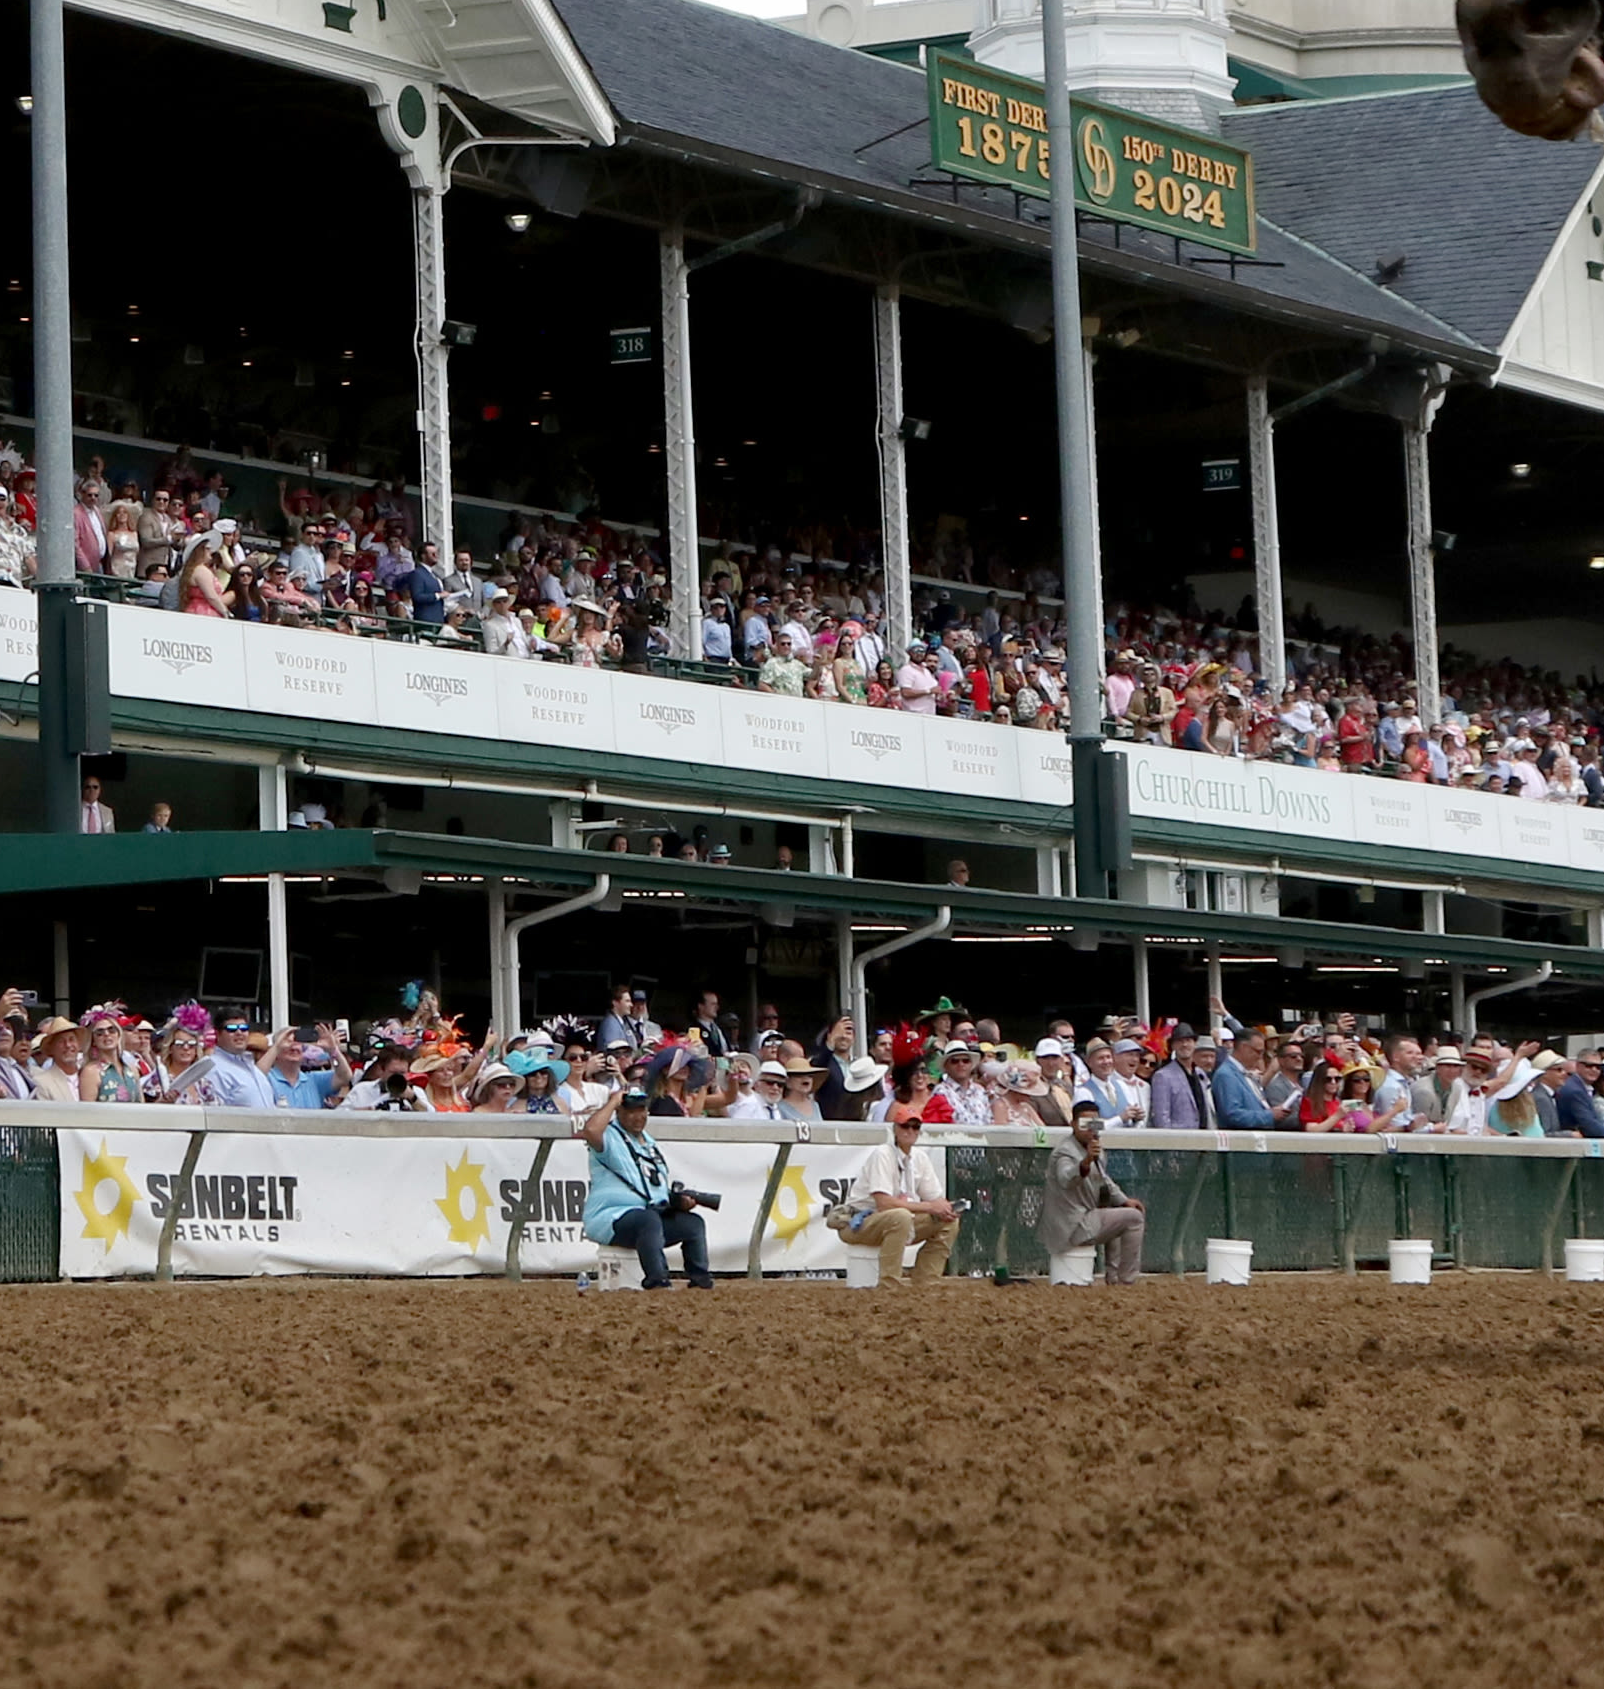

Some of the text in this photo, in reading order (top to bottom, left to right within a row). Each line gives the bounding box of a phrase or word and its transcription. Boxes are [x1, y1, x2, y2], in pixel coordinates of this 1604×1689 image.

[942, 77, 1049, 133] FIRST DER
[1122, 134, 1238, 190] 150TH DERBY
[1133, 168, 1226, 229] 2024
[618, 337, 644, 353] 318
[1208, 468, 1234, 482] 319
[142, 637, 214, 665] LONGINES
[274, 650, 348, 675] WOODFORD
[283, 674, 345, 697] RESERVE
[405, 672, 468, 697] LONGINES
[523, 683, 589, 707] WOODFORD
[531, 705, 585, 726] RESERVE
[639, 702, 696, 726] LONGINES
[744, 712, 806, 734] WOODFORD
[751, 733, 803, 753] RESERVE
[850, 729, 902, 752] LONGINES
[1135, 759, 1332, 825] CHURCHILL DOWNS
[796, 1120, 810, 1141] 13
[146, 1173, 299, 1221] SUNBELT
[498, 1178, 591, 1222] SUNB
[173, 1224, 280, 1243] RENTALS
